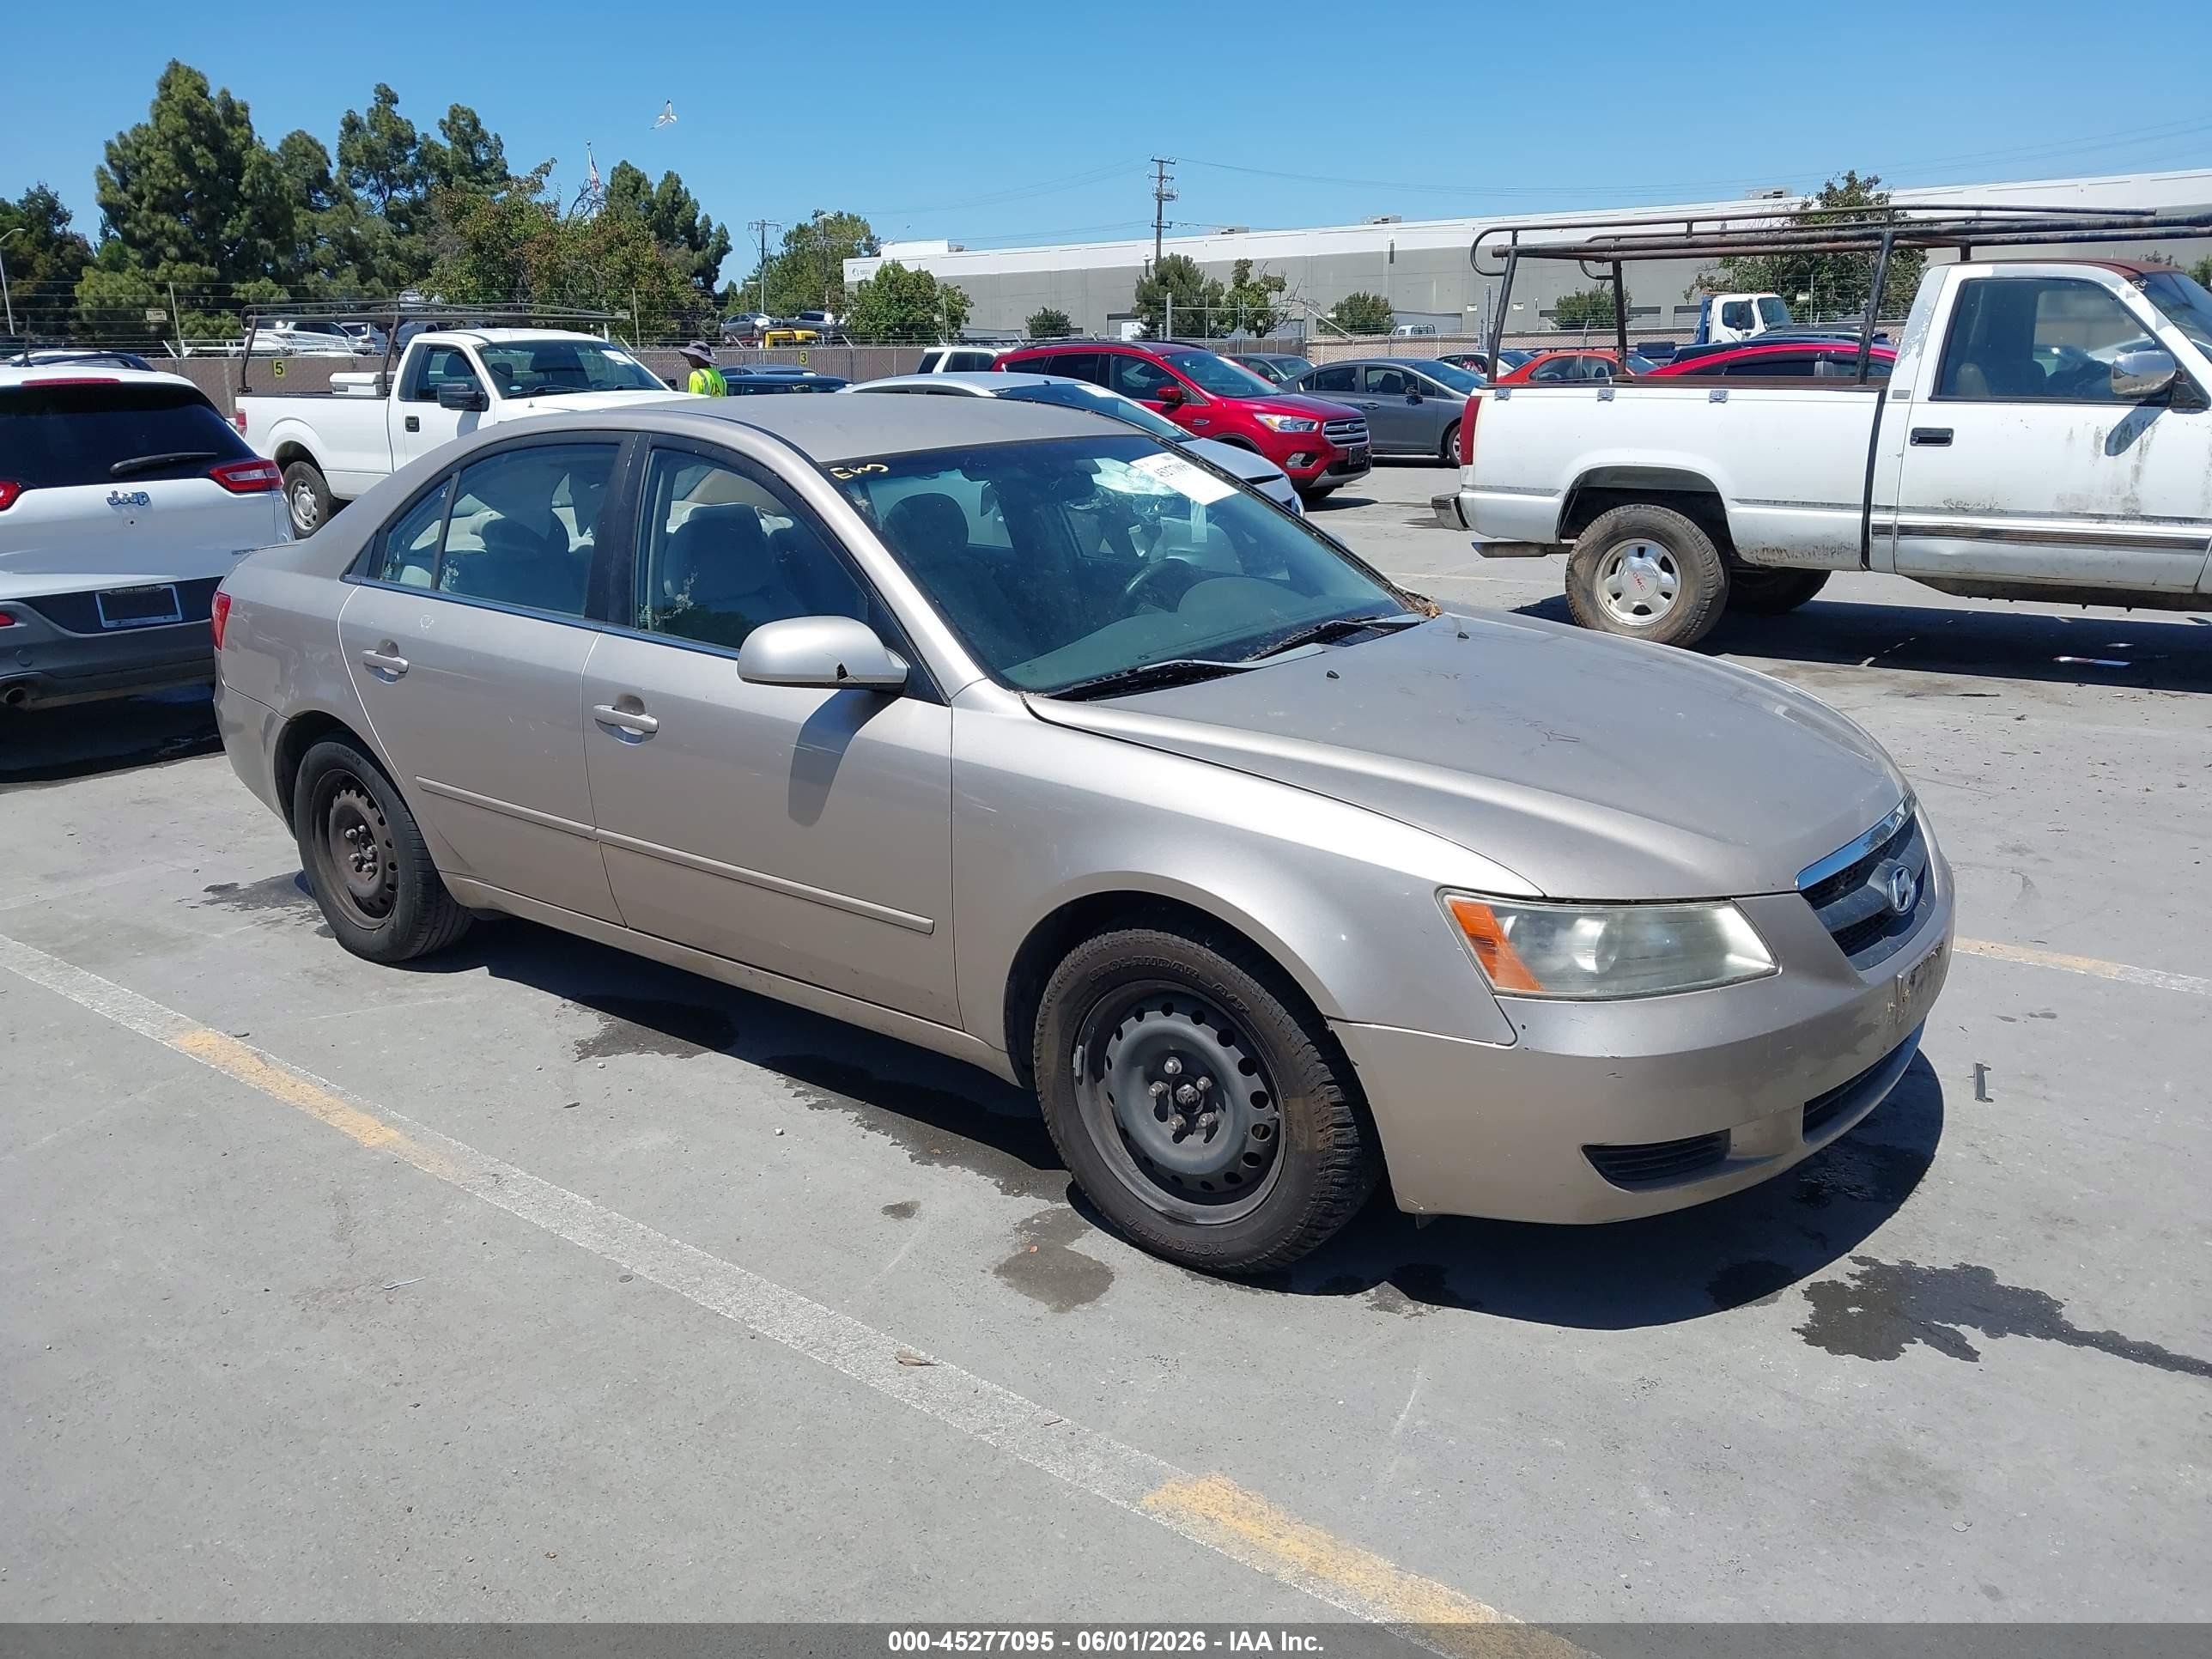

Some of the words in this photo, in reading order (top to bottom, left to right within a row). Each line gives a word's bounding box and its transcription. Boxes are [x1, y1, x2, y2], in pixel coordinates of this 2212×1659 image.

[800, 352, 807, 363] 3
[275, 362, 283, 375] 5
[106, 489, 150, 506] Jeep
[1632, 570, 1647, 592] GMC
